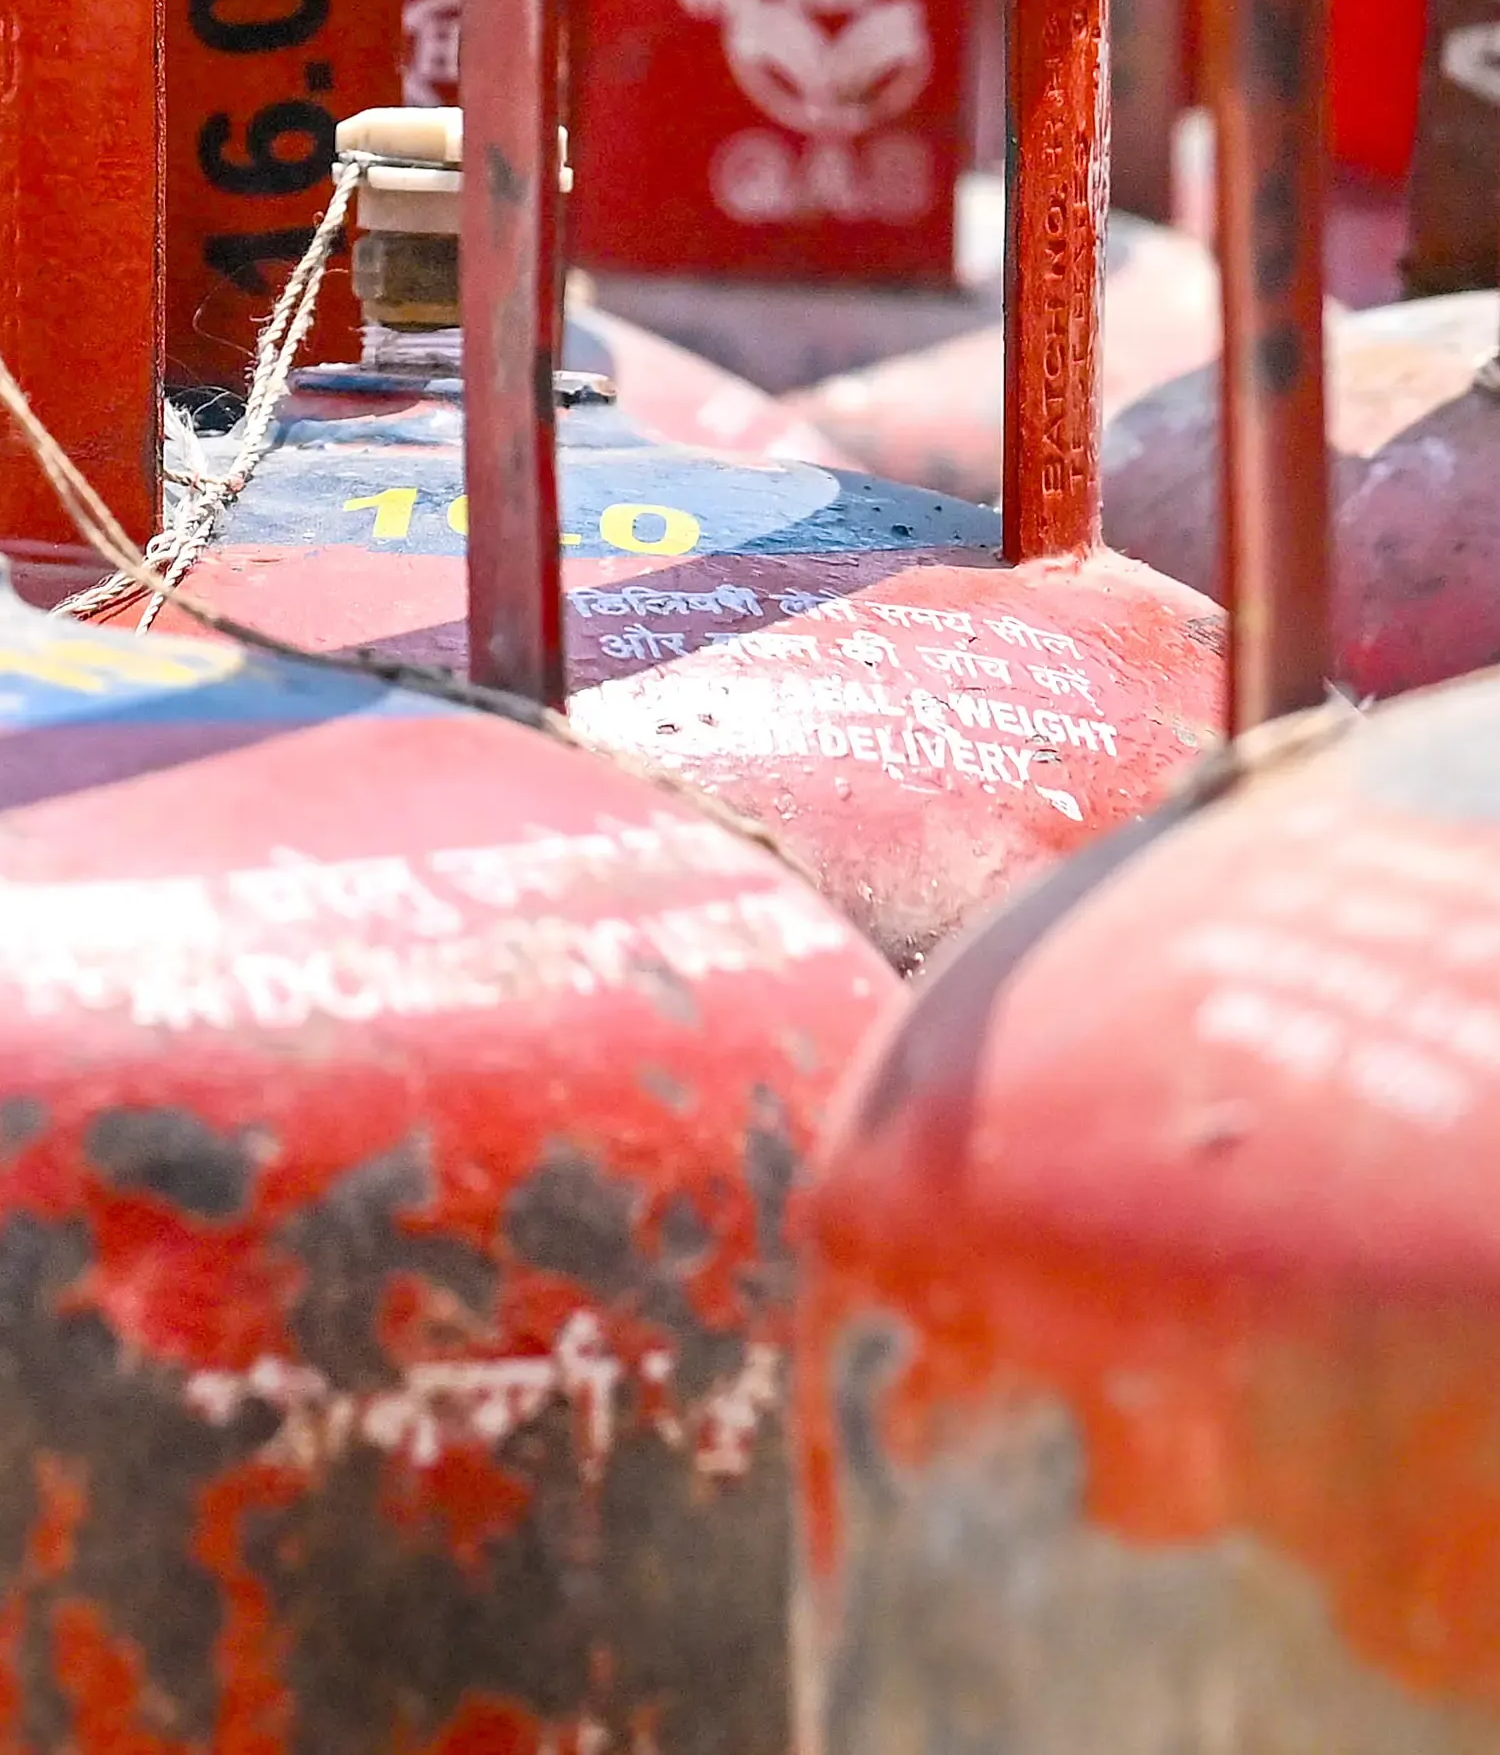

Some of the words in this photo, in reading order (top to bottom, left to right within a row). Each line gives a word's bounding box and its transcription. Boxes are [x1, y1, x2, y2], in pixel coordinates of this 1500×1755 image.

[342, 486, 702, 556] 1.0
[600, 623, 686, 661] और
[872, 599, 976, 639] समय
[990, 616, 1083, 660] सील
[815, 723, 1035, 785] DELIVERY
[948, 691, 1120, 758] WEIGHT
